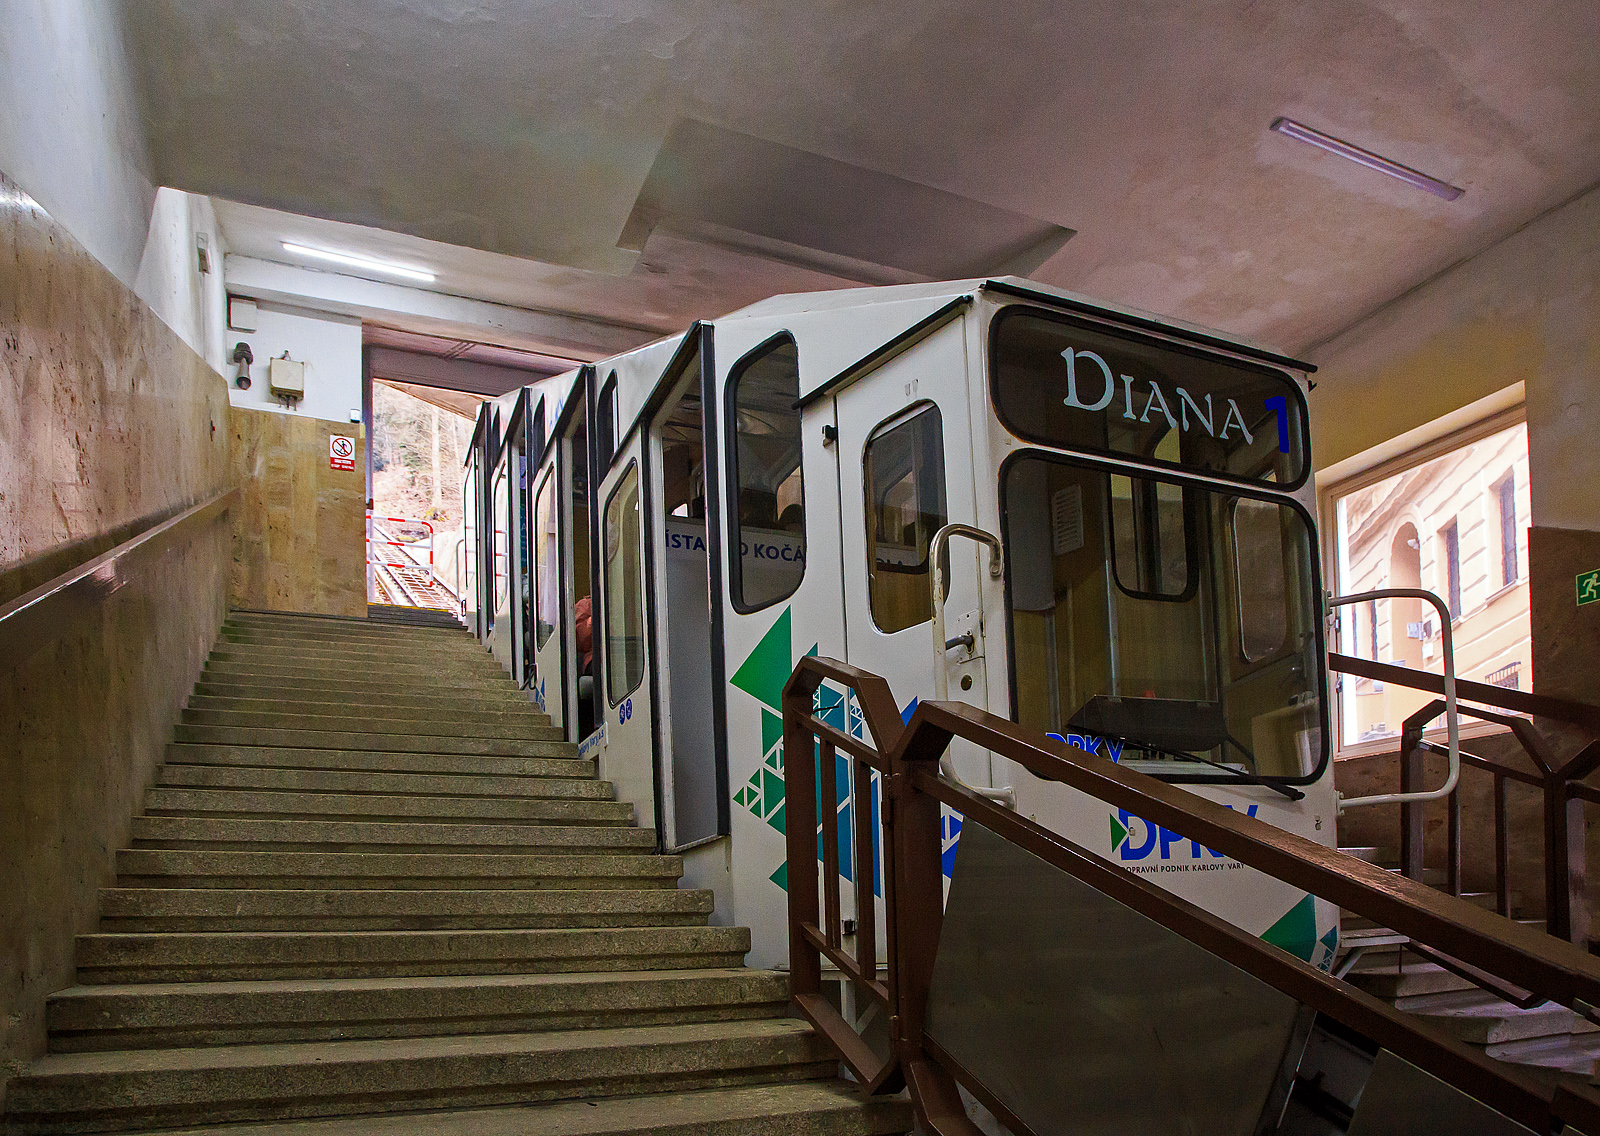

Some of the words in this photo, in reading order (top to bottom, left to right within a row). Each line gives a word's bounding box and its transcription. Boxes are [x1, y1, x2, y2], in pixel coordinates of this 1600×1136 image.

[1264, 395, 1290, 454] 1
[1160, 864, 1190, 872] PODNIK
[1192, 863, 1225, 872] KARLOVY
